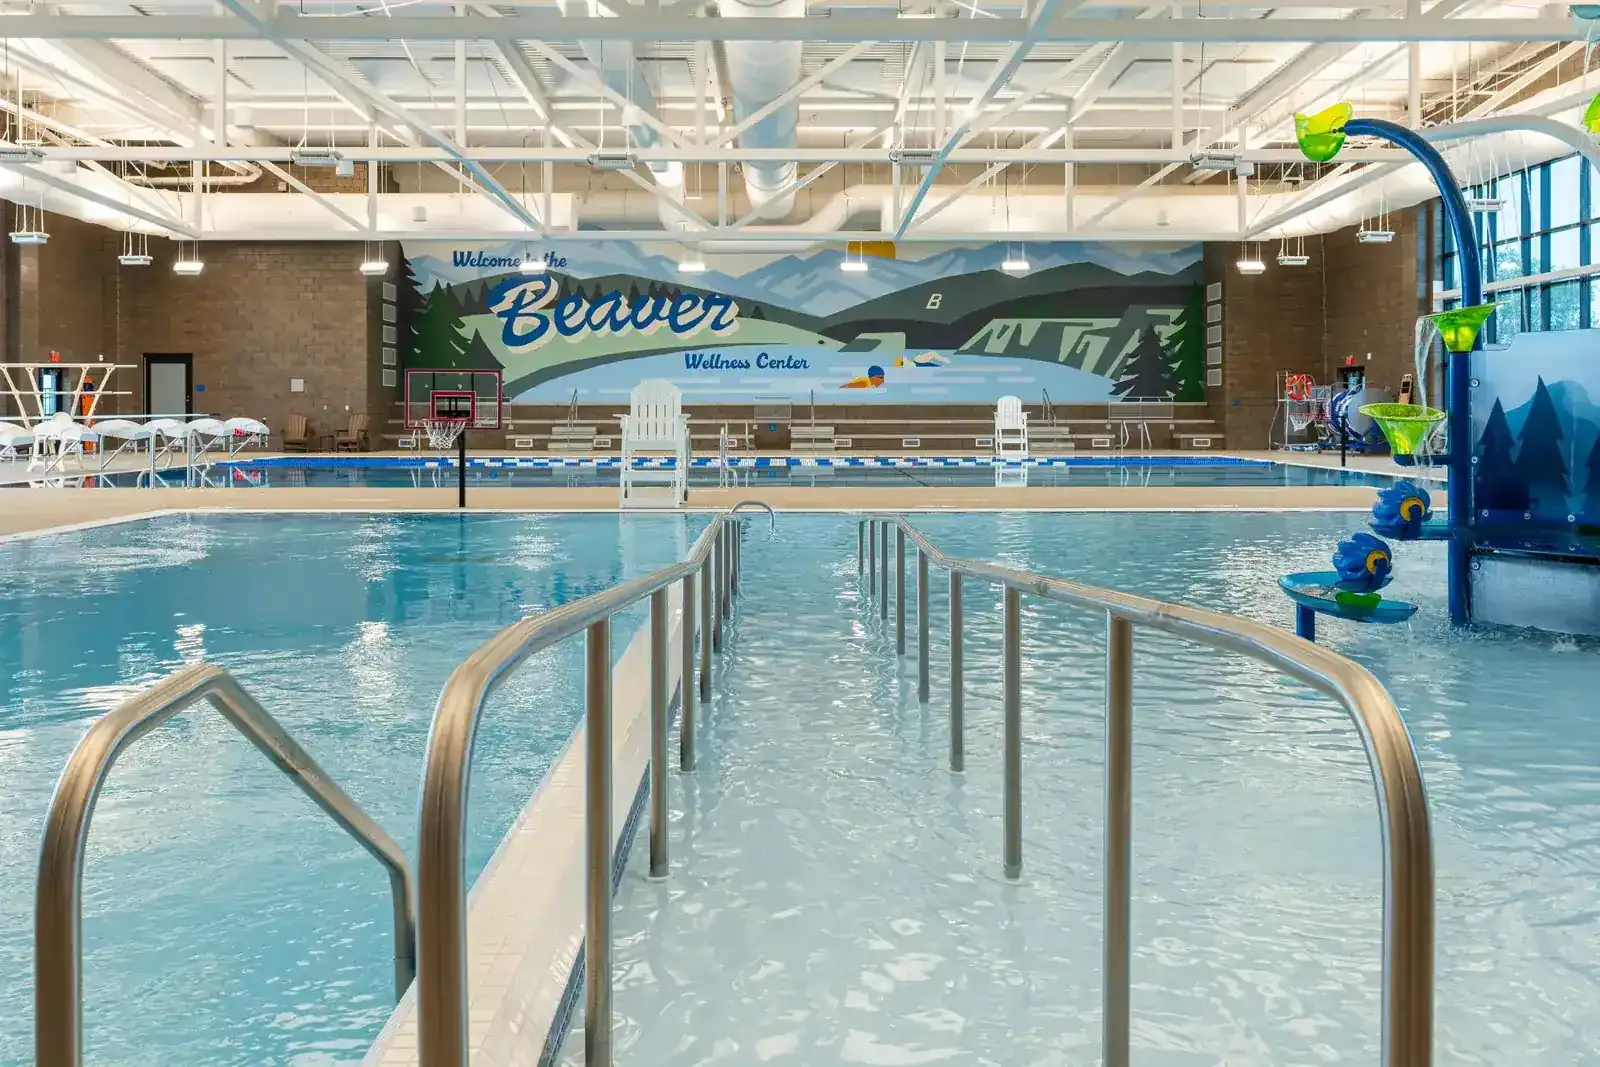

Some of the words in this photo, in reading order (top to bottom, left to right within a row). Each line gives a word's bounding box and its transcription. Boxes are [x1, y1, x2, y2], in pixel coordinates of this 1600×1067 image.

[452, 250, 520, 267] Welcome
[544, 250, 567, 267] the
[925, 293, 943, 310] B
[487, 273, 739, 353] Beaver
[684, 353, 750, 369] Wellness
[756, 352, 810, 369] Center
